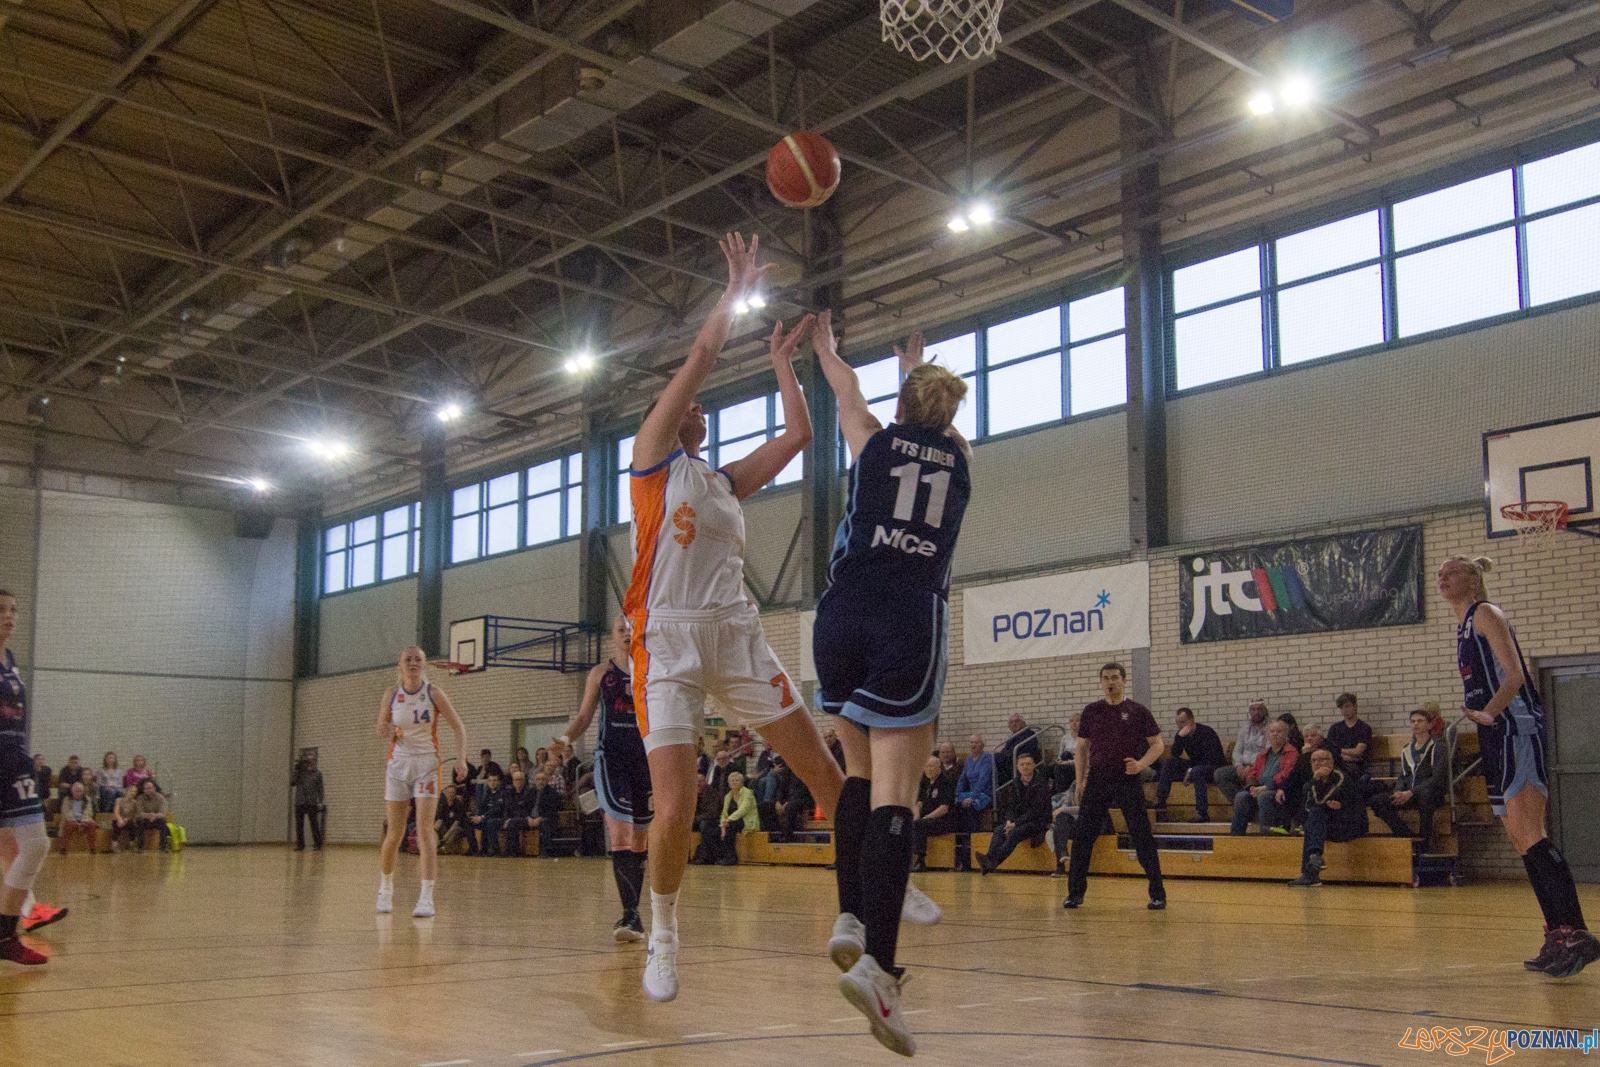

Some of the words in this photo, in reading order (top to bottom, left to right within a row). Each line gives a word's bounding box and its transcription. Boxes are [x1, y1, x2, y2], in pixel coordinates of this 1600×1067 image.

[891, 437, 919, 458] PTS
[919, 446, 955, 468] LIDER
[890, 461, 951, 529] 11
[1188, 556, 1264, 640] jtc
[769, 672, 794, 709] 7
[413, 709, 431, 724] 14
[12, 778, 39, 800] 12
[418, 780, 435, 795] 14
